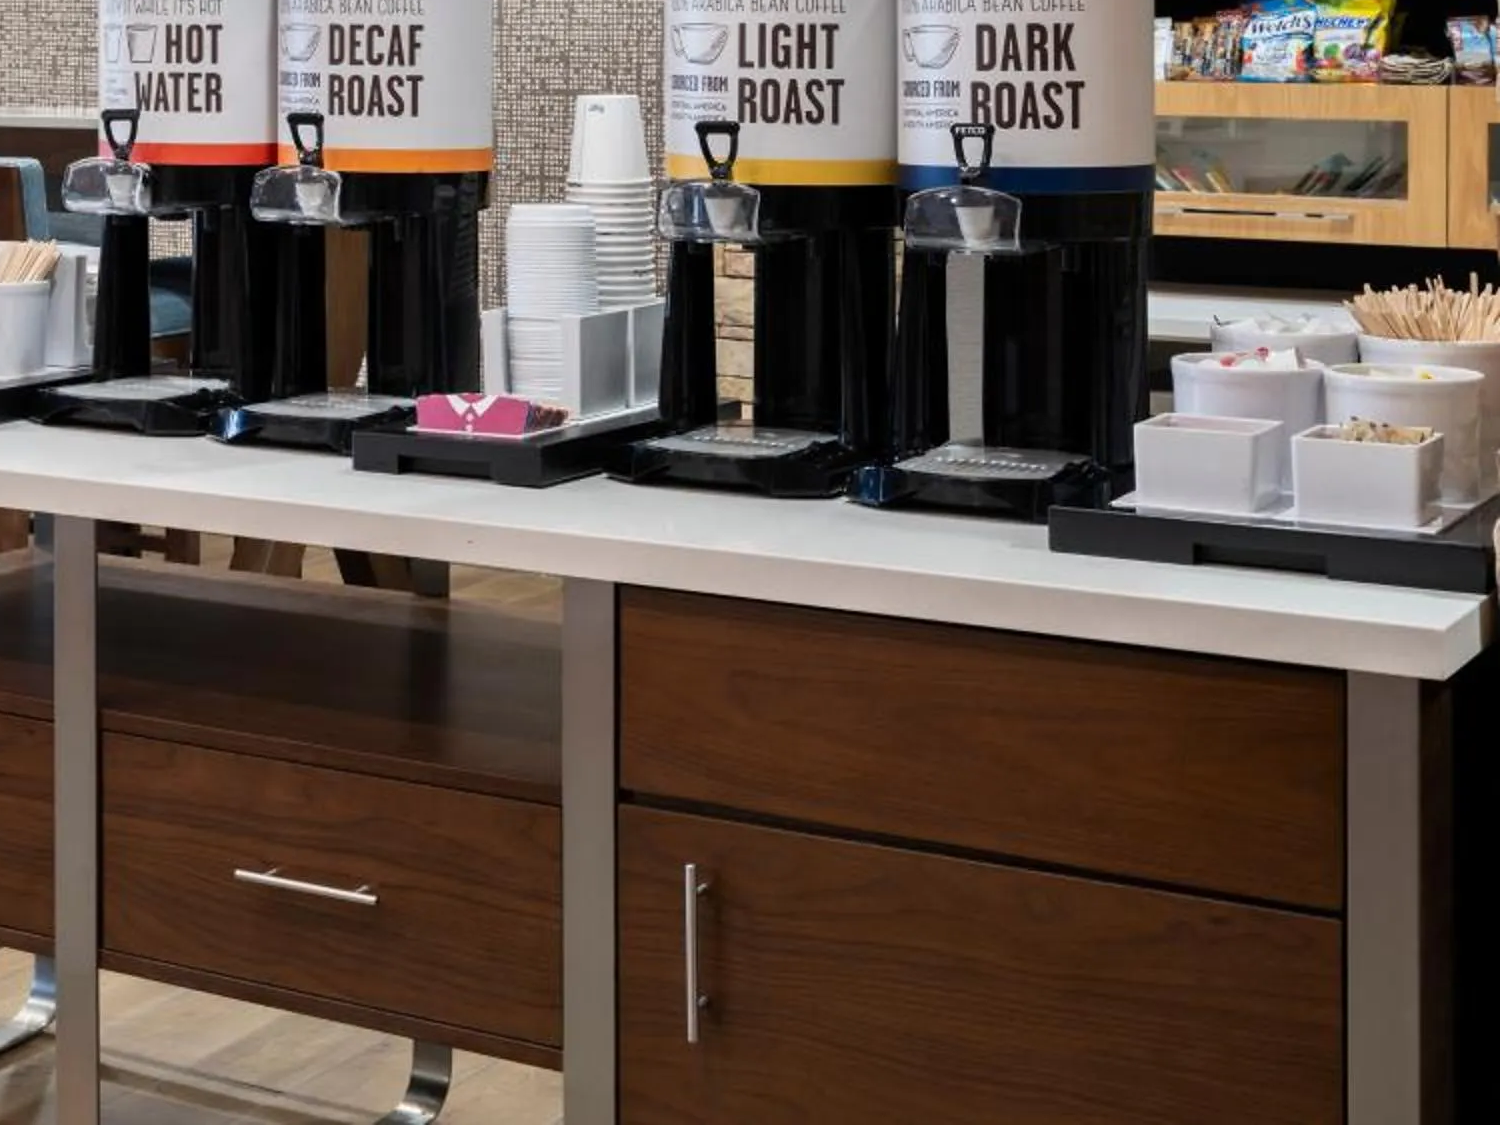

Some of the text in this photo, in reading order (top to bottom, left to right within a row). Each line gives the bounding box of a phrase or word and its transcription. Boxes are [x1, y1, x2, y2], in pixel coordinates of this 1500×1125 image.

[165, 23, 223, 64] HOT
[328, 23, 425, 66] DECAF
[738, 23, 840, 69] LIGHT
[975, 23, 1077, 71] DARK
[133, 72, 223, 113] WATER
[328, 73, 425, 117] ROAST
[702, 75, 728, 92] FROM
[737, 77, 845, 125] ROAST
[933, 80, 961, 98] FROM
[970, 81, 1086, 130] ROAST
